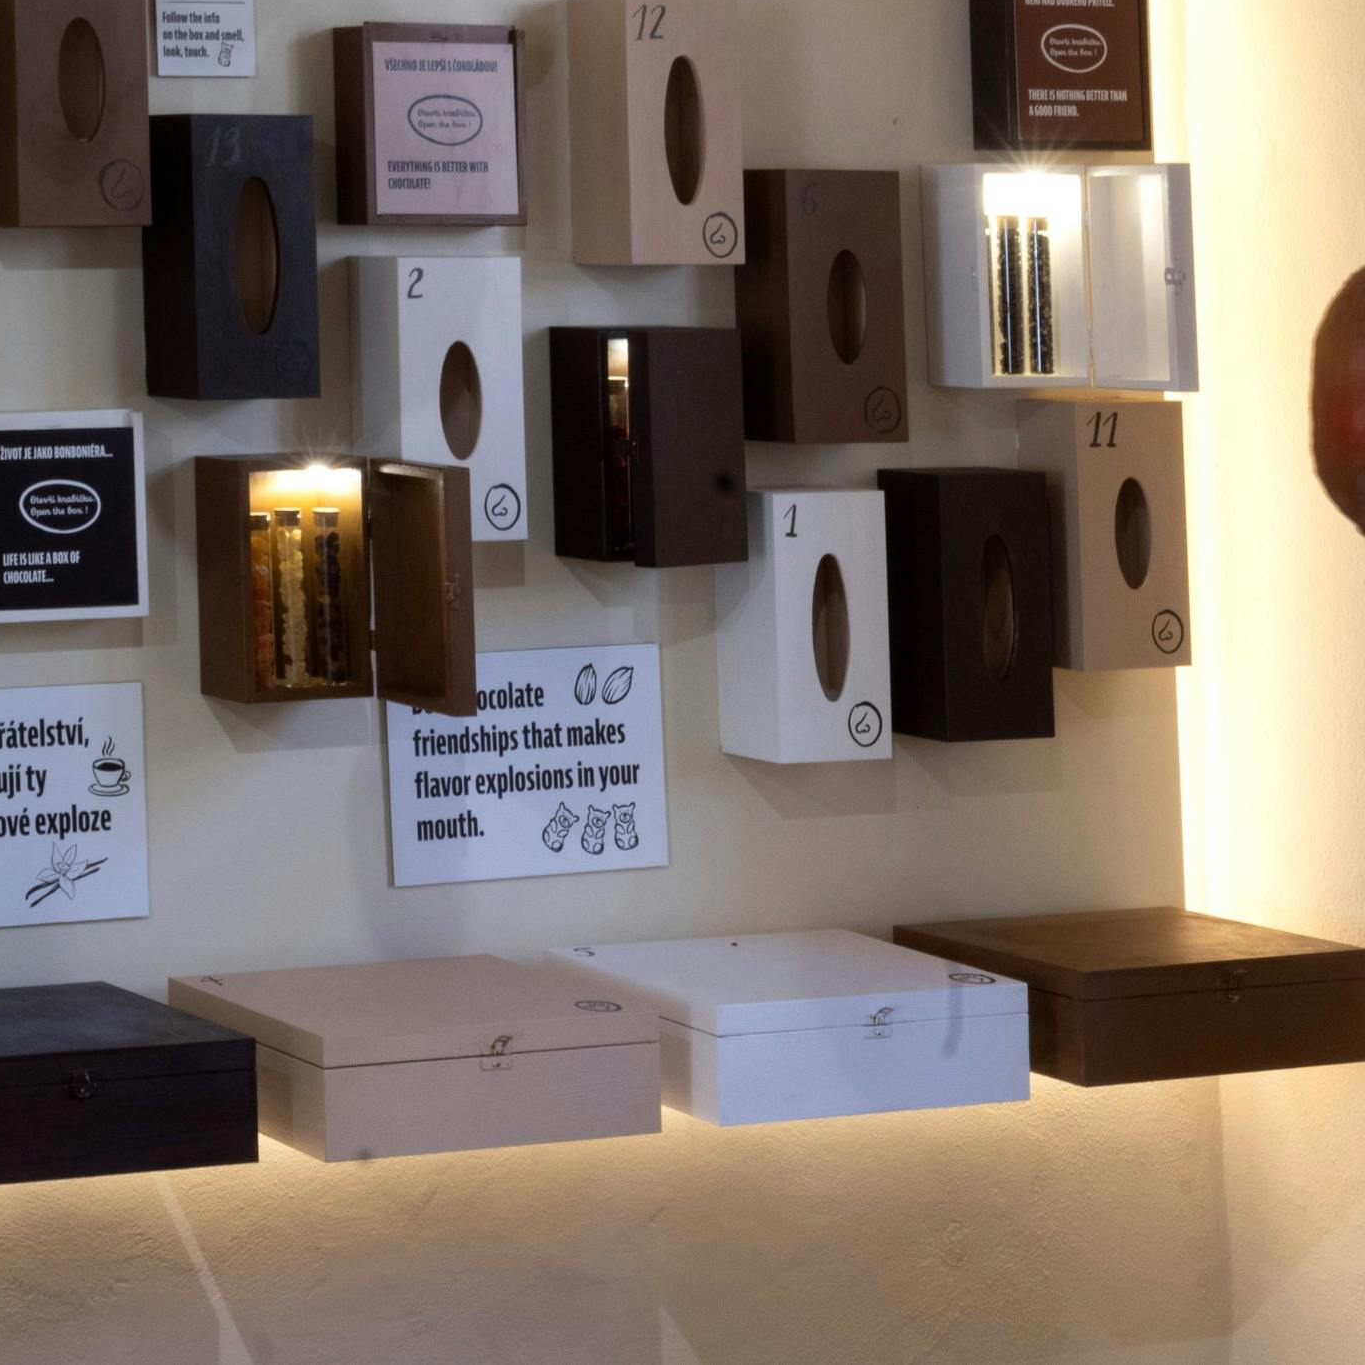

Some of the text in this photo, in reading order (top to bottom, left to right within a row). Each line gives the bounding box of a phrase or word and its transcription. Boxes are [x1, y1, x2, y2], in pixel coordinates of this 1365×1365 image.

[162, 11, 220, 24] Follow the info
[630, 4, 666, 41] 12
[163, 30, 173, 40] on
[175, 29, 187, 40] the
[189, 29, 203, 41] box
[205, 29, 219, 41] and
[163, 46, 209, 58] look, touch.
[1028, 89, 1127, 102] THERE IS NOTHING BETTER THAN
[1029, 105, 1079, 117] A GOOD FRIEND.
[388, 161, 488, 173] EVERYTHING IS BETTER WITH
[388, 177, 431, 190] CHOCOLATE!
[407, 267, 424, 300] 2
[1086, 411, 1118, 448] 11
[0, 445, 22, 460] ŽIVOT
[24, 447, 33, 459] JE
[33, 446, 53, 460] JAKO
[30, 508, 51, 518] Open
[53, 507, 65, 515] the
[781, 503, 796, 538] 1
[2, 551, 80, 566] LIFE IS LIKE A BOX OF
[3, 570, 54, 584] CHOCOLATE...
[477, 682, 545, 711] ocolate
[412, 718, 626, 757] friendships that makes
[26, 765, 47, 797] ty
[414, 761, 640, 799] flavor explosions in your
[35, 804, 113, 840] exploze
[417, 810, 485, 842] mouth.
